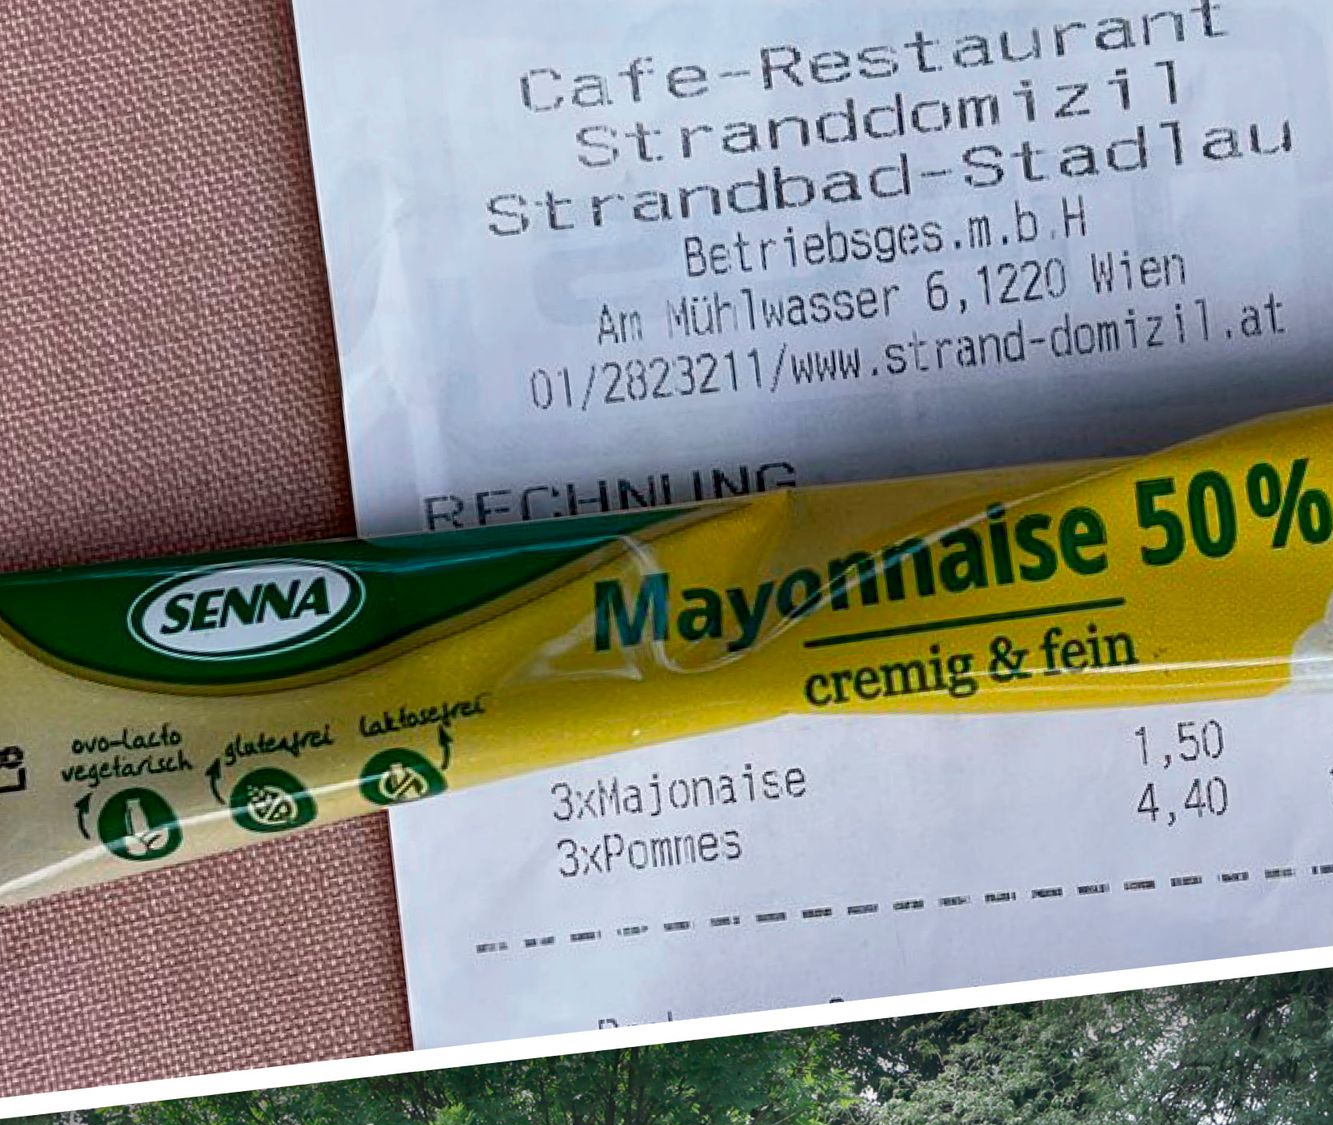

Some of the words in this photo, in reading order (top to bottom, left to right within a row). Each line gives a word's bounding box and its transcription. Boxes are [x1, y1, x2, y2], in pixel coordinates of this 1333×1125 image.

[519, 2, 1228, 116] Cafe-Restaurant
[575, 61, 1180, 169] Stranddomizil
[486, 115, 1292, 237] Strandbad-Stadlau
[683, 197, 1087, 277] Betriebsges.m.b.H
[598, 302, 643, 345] Am
[666, 281, 898, 338] Mühlwasser
[925, 254, 1067, 315] 6,1220
[1091, 249, 1187, 295] Wien
[530, 294, 1285, 411] 01/2823211/www.strand-domizil.at
[159, 576, 333, 634] SENNA
[592, 505, 1109, 653] Mayonnaise
[804, 644, 978, 708] cremig
[986, 637, 1034, 684] &
[1040, 624, 1138, 674] fein
[71, 722, 183, 755] ovo-lacto
[224, 721, 334, 766] glutenfrei
[359, 692, 490, 738] laktosefrei
[60, 748, 194, 788] vegetarisch
[550, 760, 808, 822] 3xMajonaise
[1134, 718, 1225, 770] 1,50
[556, 829, 743, 879] 3xPommes
[1137, 776, 1230, 827] 4,40
